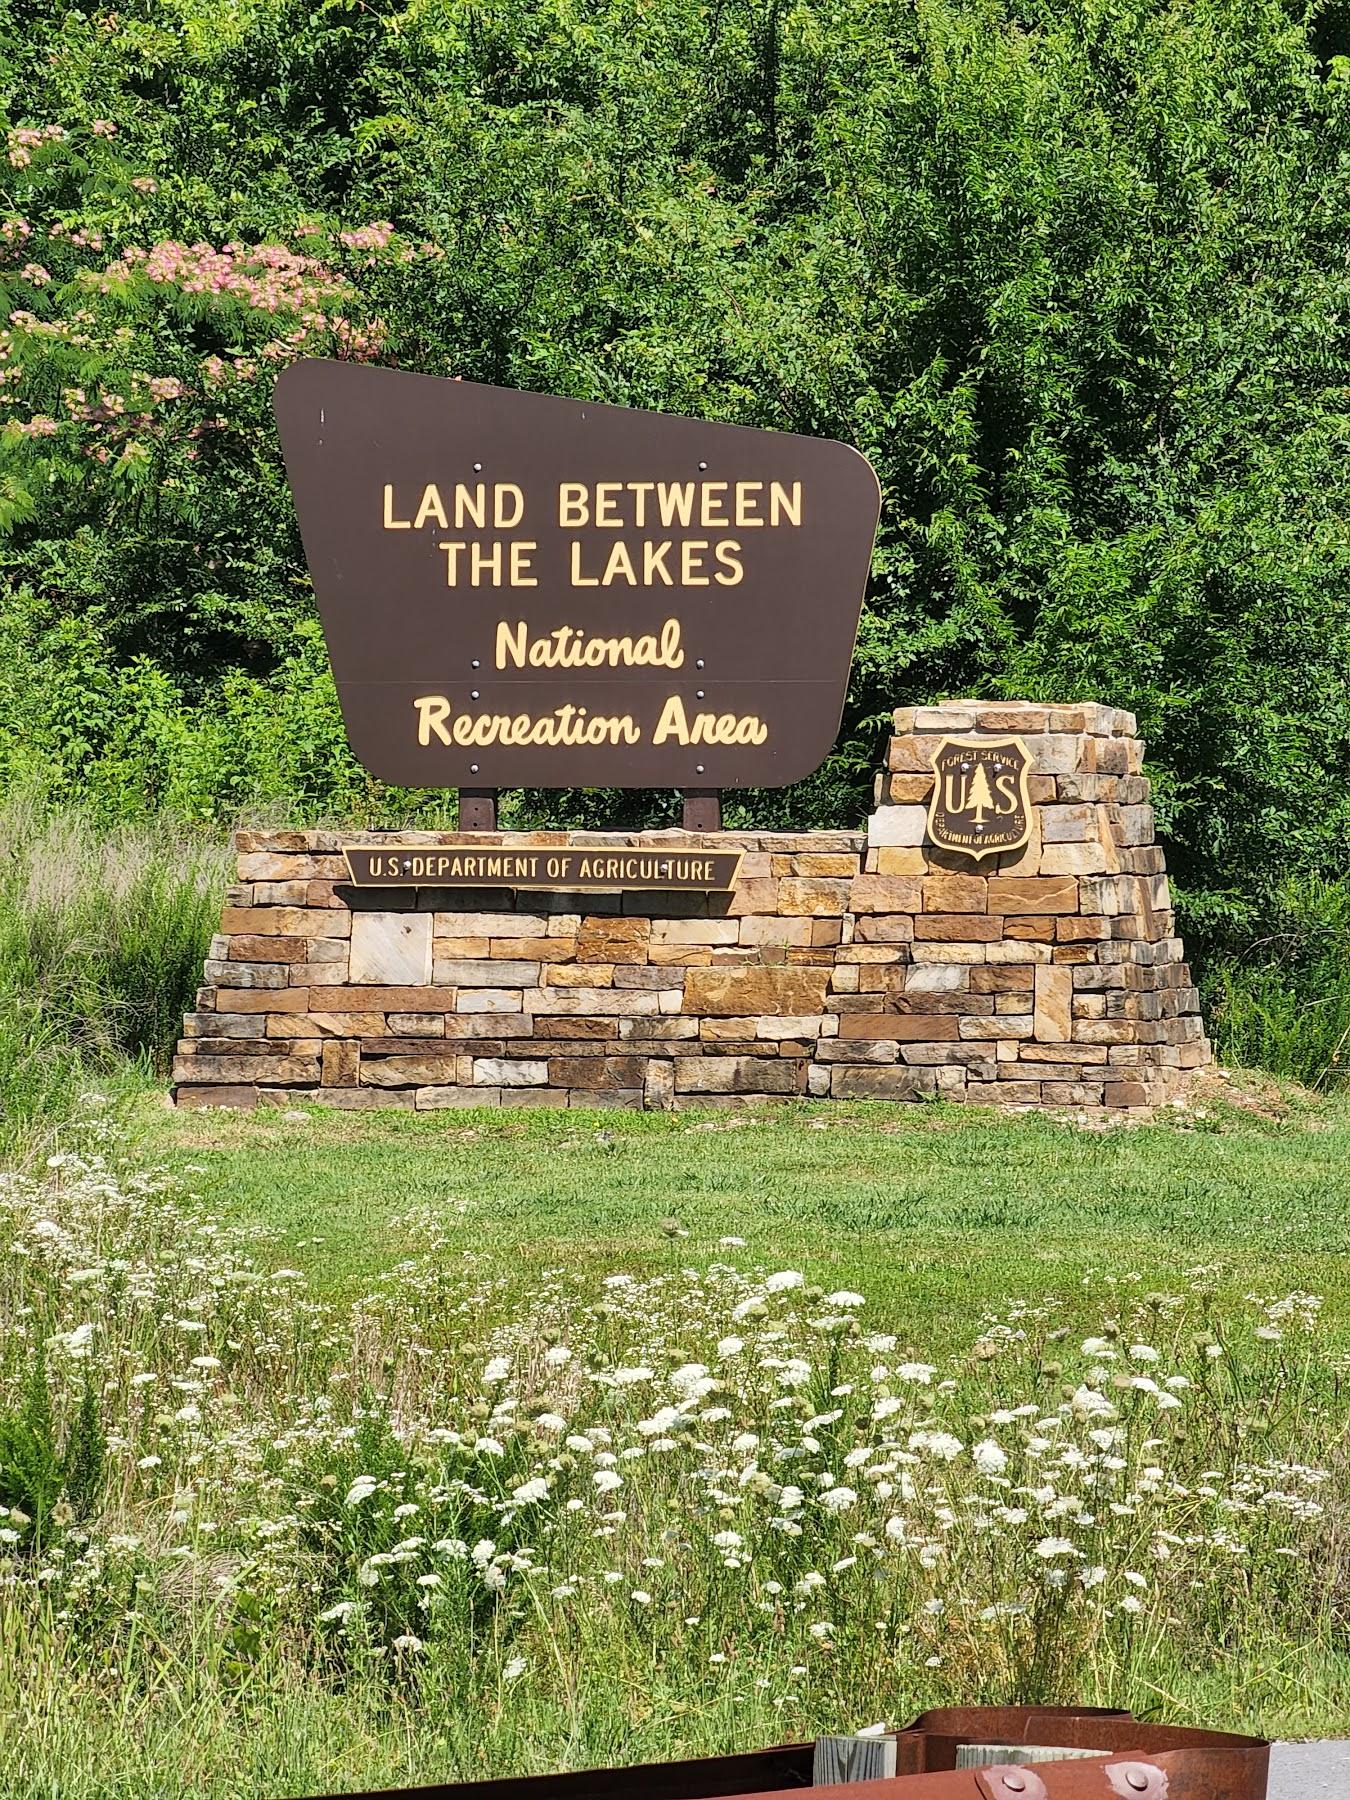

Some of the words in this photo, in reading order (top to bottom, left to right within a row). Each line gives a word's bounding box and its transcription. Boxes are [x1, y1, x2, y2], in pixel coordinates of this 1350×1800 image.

[383, 483, 524, 529] LAND
[559, 481, 802, 527] BETWEEN
[439, 541, 538, 586] THE
[571, 539, 744, 586] LAKES
[496, 618, 685, 669] National
[413, 695, 640, 746] Recreation
[652, 694, 768, 746] Area
[941, 750, 978, 771] FOREST
[981, 750, 1020, 771] SERVICE
[369, 857, 403, 877] U.S.
[412, 857, 537, 879] DEPARTMENT
[547, 857, 572, 879] OF
[579, 858, 715, 881] AGRICULTURE
